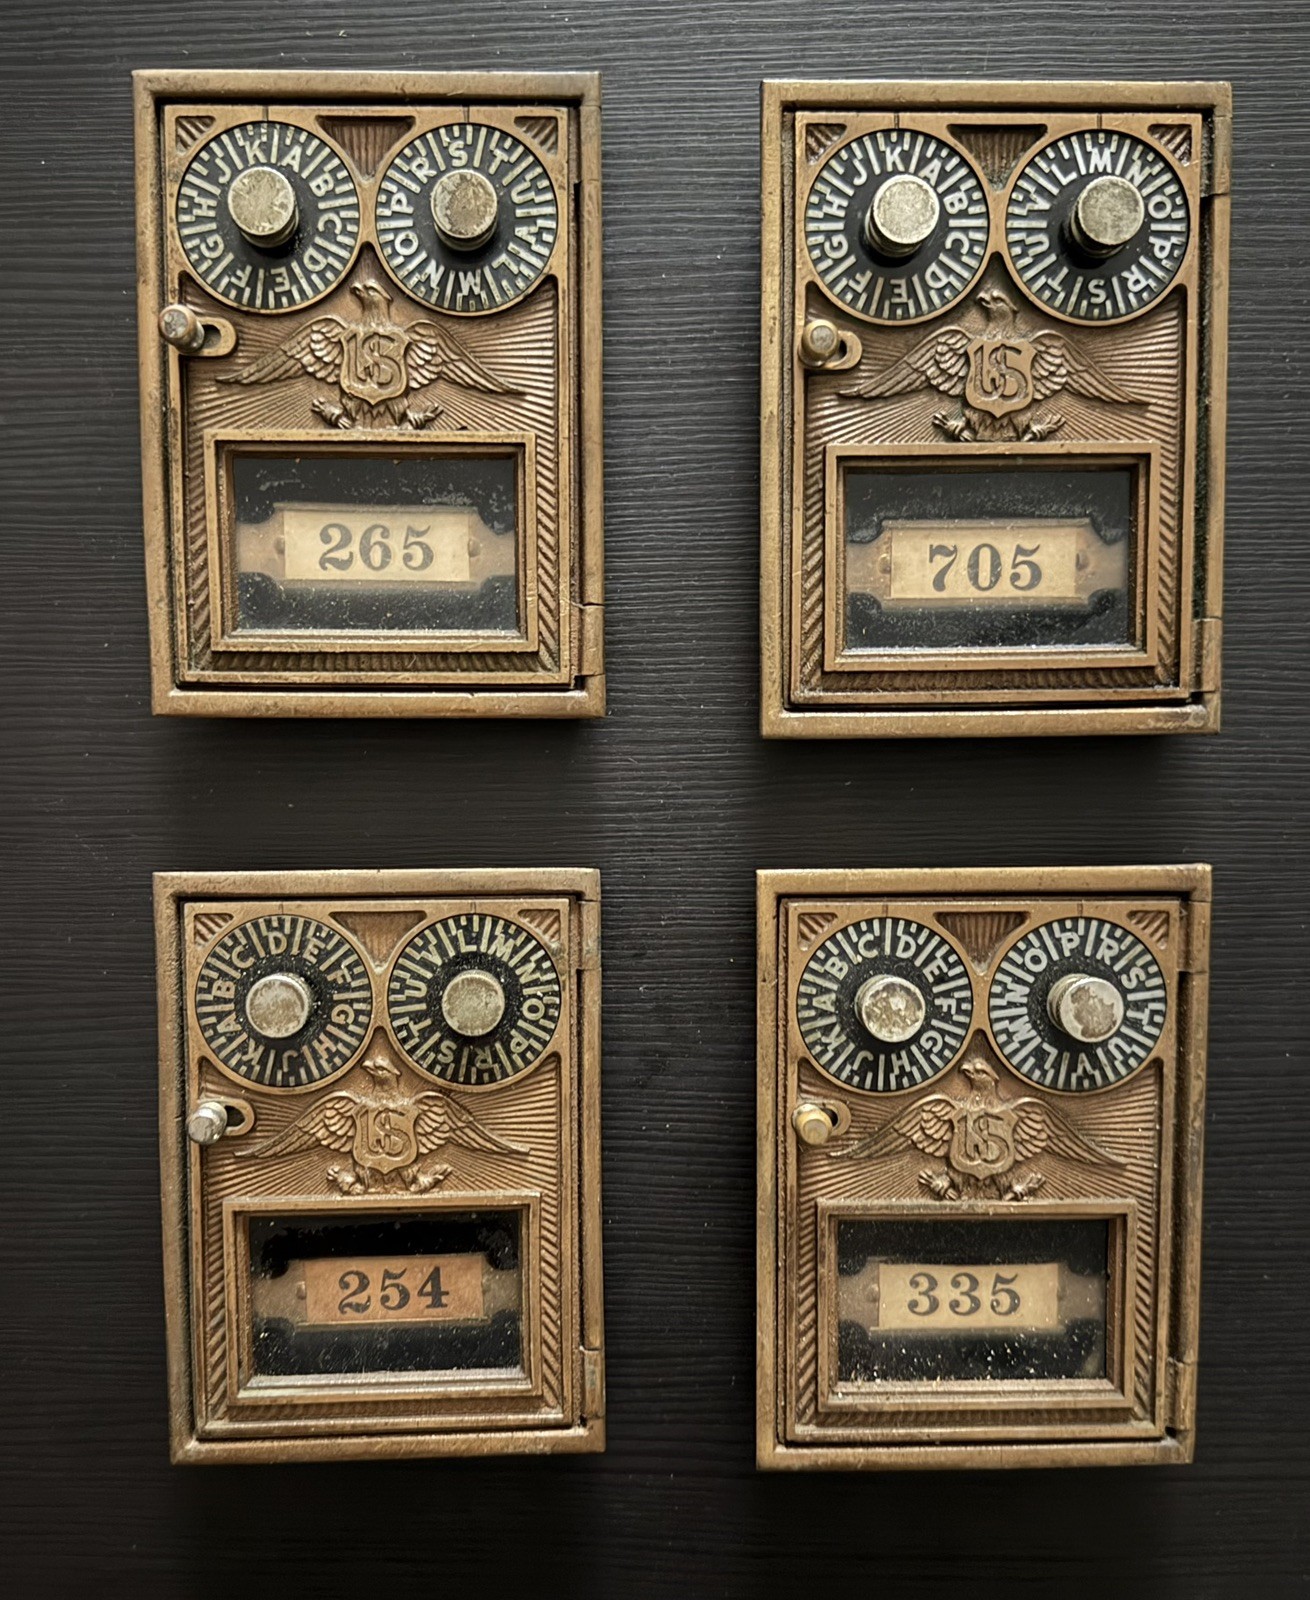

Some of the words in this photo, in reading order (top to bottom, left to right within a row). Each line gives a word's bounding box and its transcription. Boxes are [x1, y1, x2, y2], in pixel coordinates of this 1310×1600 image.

[245, 140, 267, 166] K
[280, 145, 302, 173] A
[449, 141, 468, 167] S
[489, 148, 509, 175] T
[885, 147, 905, 172] K
[1089, 148, 1112, 174] M
[215, 158, 231, 184] J
[410, 157, 437, 184] R
[853, 158, 867, 186] J
[918, 158, 942, 187] A
[1050, 164, 1077, 185] L
[1125, 159, 1151, 188] N
[309, 172, 334, 197] B
[511, 181, 535, 204] U
[193, 197, 217, 217] H
[391, 192, 413, 214] P
[823, 193, 848, 218] H
[943, 191, 969, 214] B
[1148, 195, 1172, 219] O
[318, 213, 342, 234] C
[201, 234, 224, 258] G
[395, 231, 418, 255] O
[824, 234, 848, 259] G
[945, 231, 969, 255] C
[1025, 234, 1049, 256] U
[1149, 236, 1172, 259] P
[303, 248, 327, 272] D
[492, 254, 519, 274] L
[231, 264, 252, 288] F
[271, 268, 291, 292] E
[421, 259, 445, 288] N
[459, 269, 481, 296] M
[848, 270, 872, 294] F
[925, 262, 949, 289] D
[1048, 266, 1068, 292] T
[1121, 264, 1152, 292] R
[890, 279, 909, 303] E
[1088, 279, 1106, 304] S
[318, 522, 435, 572] 265
[928, 542, 1043, 592] 705
[268, 931, 287, 955] D
[303, 937, 326, 964] E
[457, 930, 477, 953] L
[488, 934, 515, 962] M
[858, 933, 878, 958] C
[896, 934, 916, 959] D
[1060, 932, 1080, 957] P
[1096, 938, 1119, 965] R
[232, 944, 255, 969] C
[824, 956, 849, 981] B
[1024, 948, 1048, 973] O
[327, 965, 352, 984] F
[515, 962, 542, 984] N
[923, 957, 948, 983] E
[1121, 967, 1146, 990] S
[212, 979, 235, 999] B
[405, 978, 427, 997] U
[1006, 979, 1030, 1003] N
[331, 1003, 354, 1025] G
[522, 998, 545, 1020] O
[812, 993, 836, 1012] A
[934, 998, 957, 1015] F
[216, 1012, 242, 1034] A
[409, 1018, 432, 1037] T
[1008, 1015, 1037, 1042] M
[1126, 1008, 1150, 1025] T
[312, 1032, 337, 1059] H
[510, 1029, 529, 1053] P
[821, 1024, 847, 1052] K
[920, 1030, 943, 1053] G
[1108, 1037, 1132, 1062] U
[242, 1038, 265, 1066] K
[283, 1051, 298, 1073] J
[437, 1040, 457, 1064] S
[475, 1046, 493, 1069] R
[853, 1051, 874, 1070] J
[891, 1051, 911, 1075] H
[1042, 1042, 1058, 1070] L
[337, 1265, 449, 1315] 254
[907, 1271, 1021, 1317] 335
